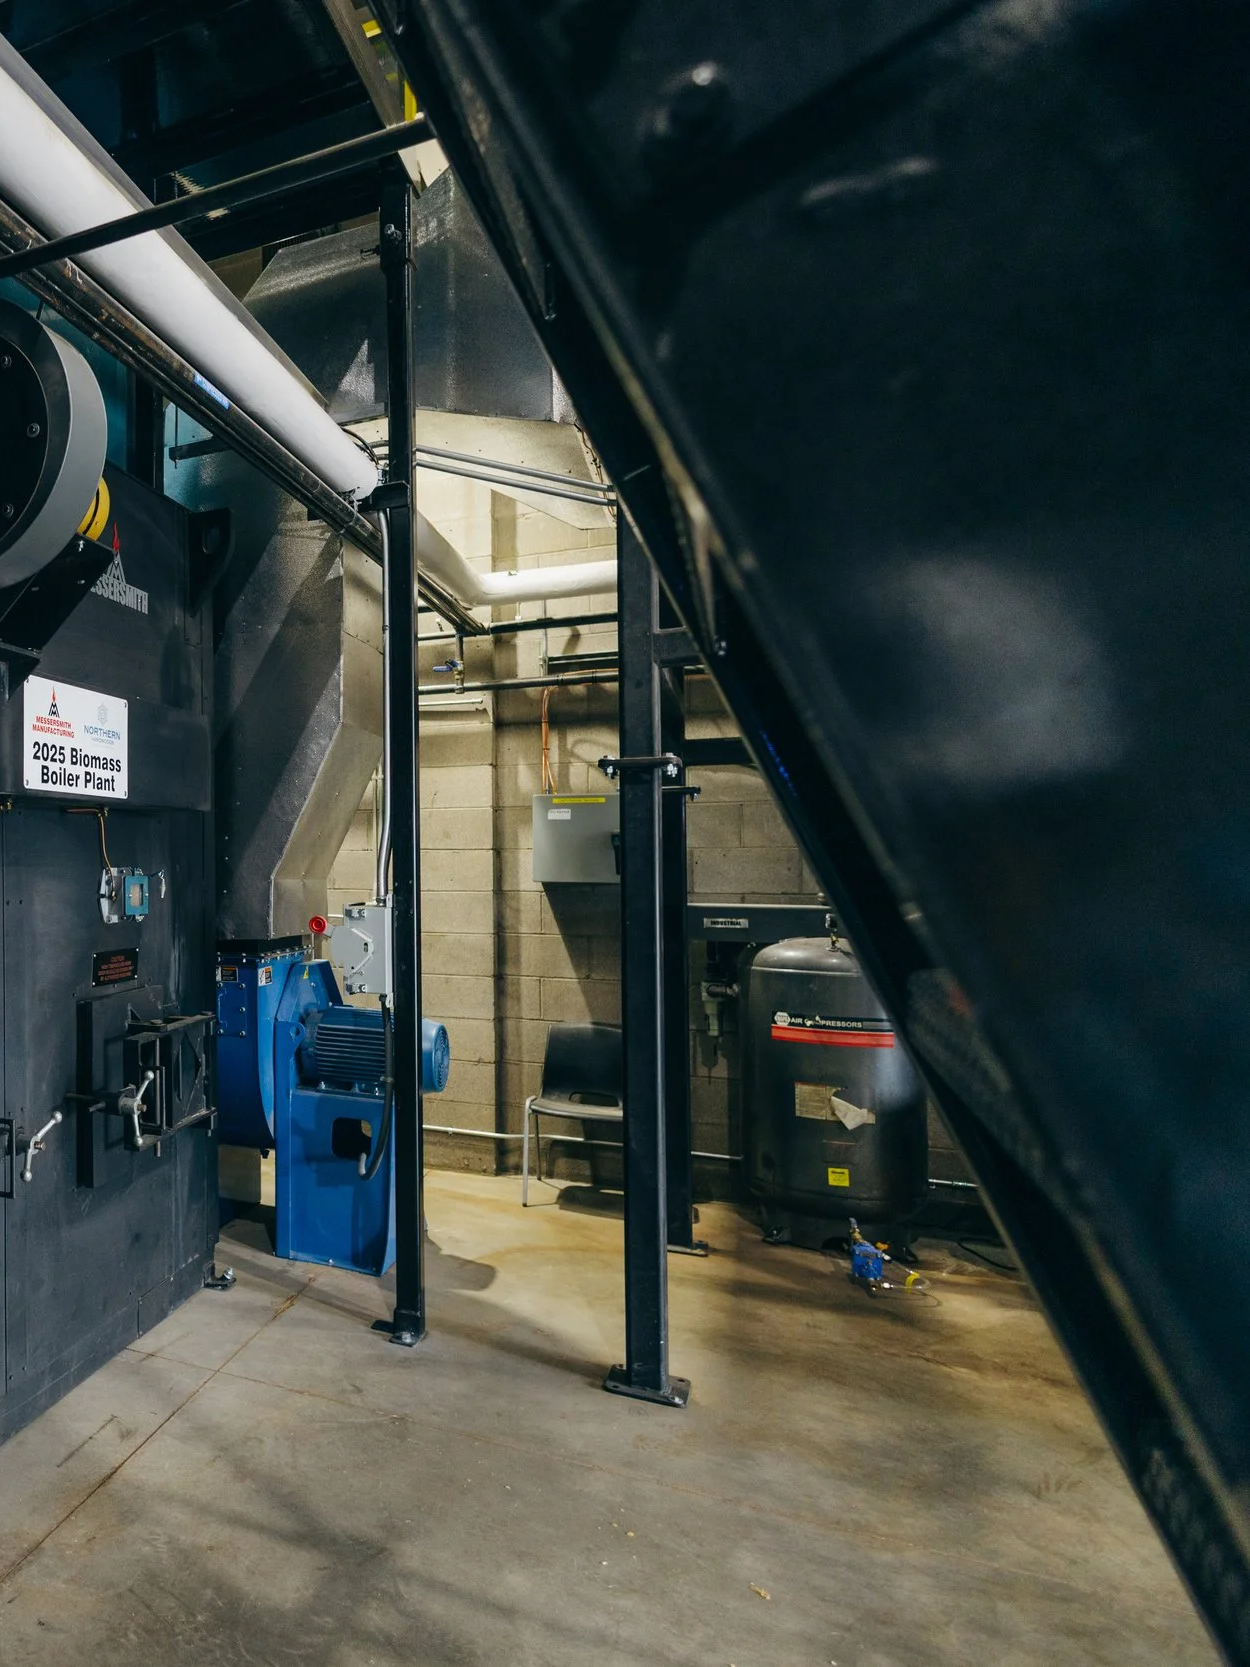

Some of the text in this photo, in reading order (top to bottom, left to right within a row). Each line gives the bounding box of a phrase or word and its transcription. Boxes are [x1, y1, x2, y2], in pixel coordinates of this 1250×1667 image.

[90, 573, 148, 615] SSERSMITH
[32, 723, 75, 738] MANUFACTURING
[36, 716, 71, 729] MESSERSMITH
[84, 724, 121, 740] NORTHERN
[32, 741, 121, 773] 2025 Biomass
[41, 764, 115, 792] Boiler Plant
[791, 1016, 803, 1024] AIR
